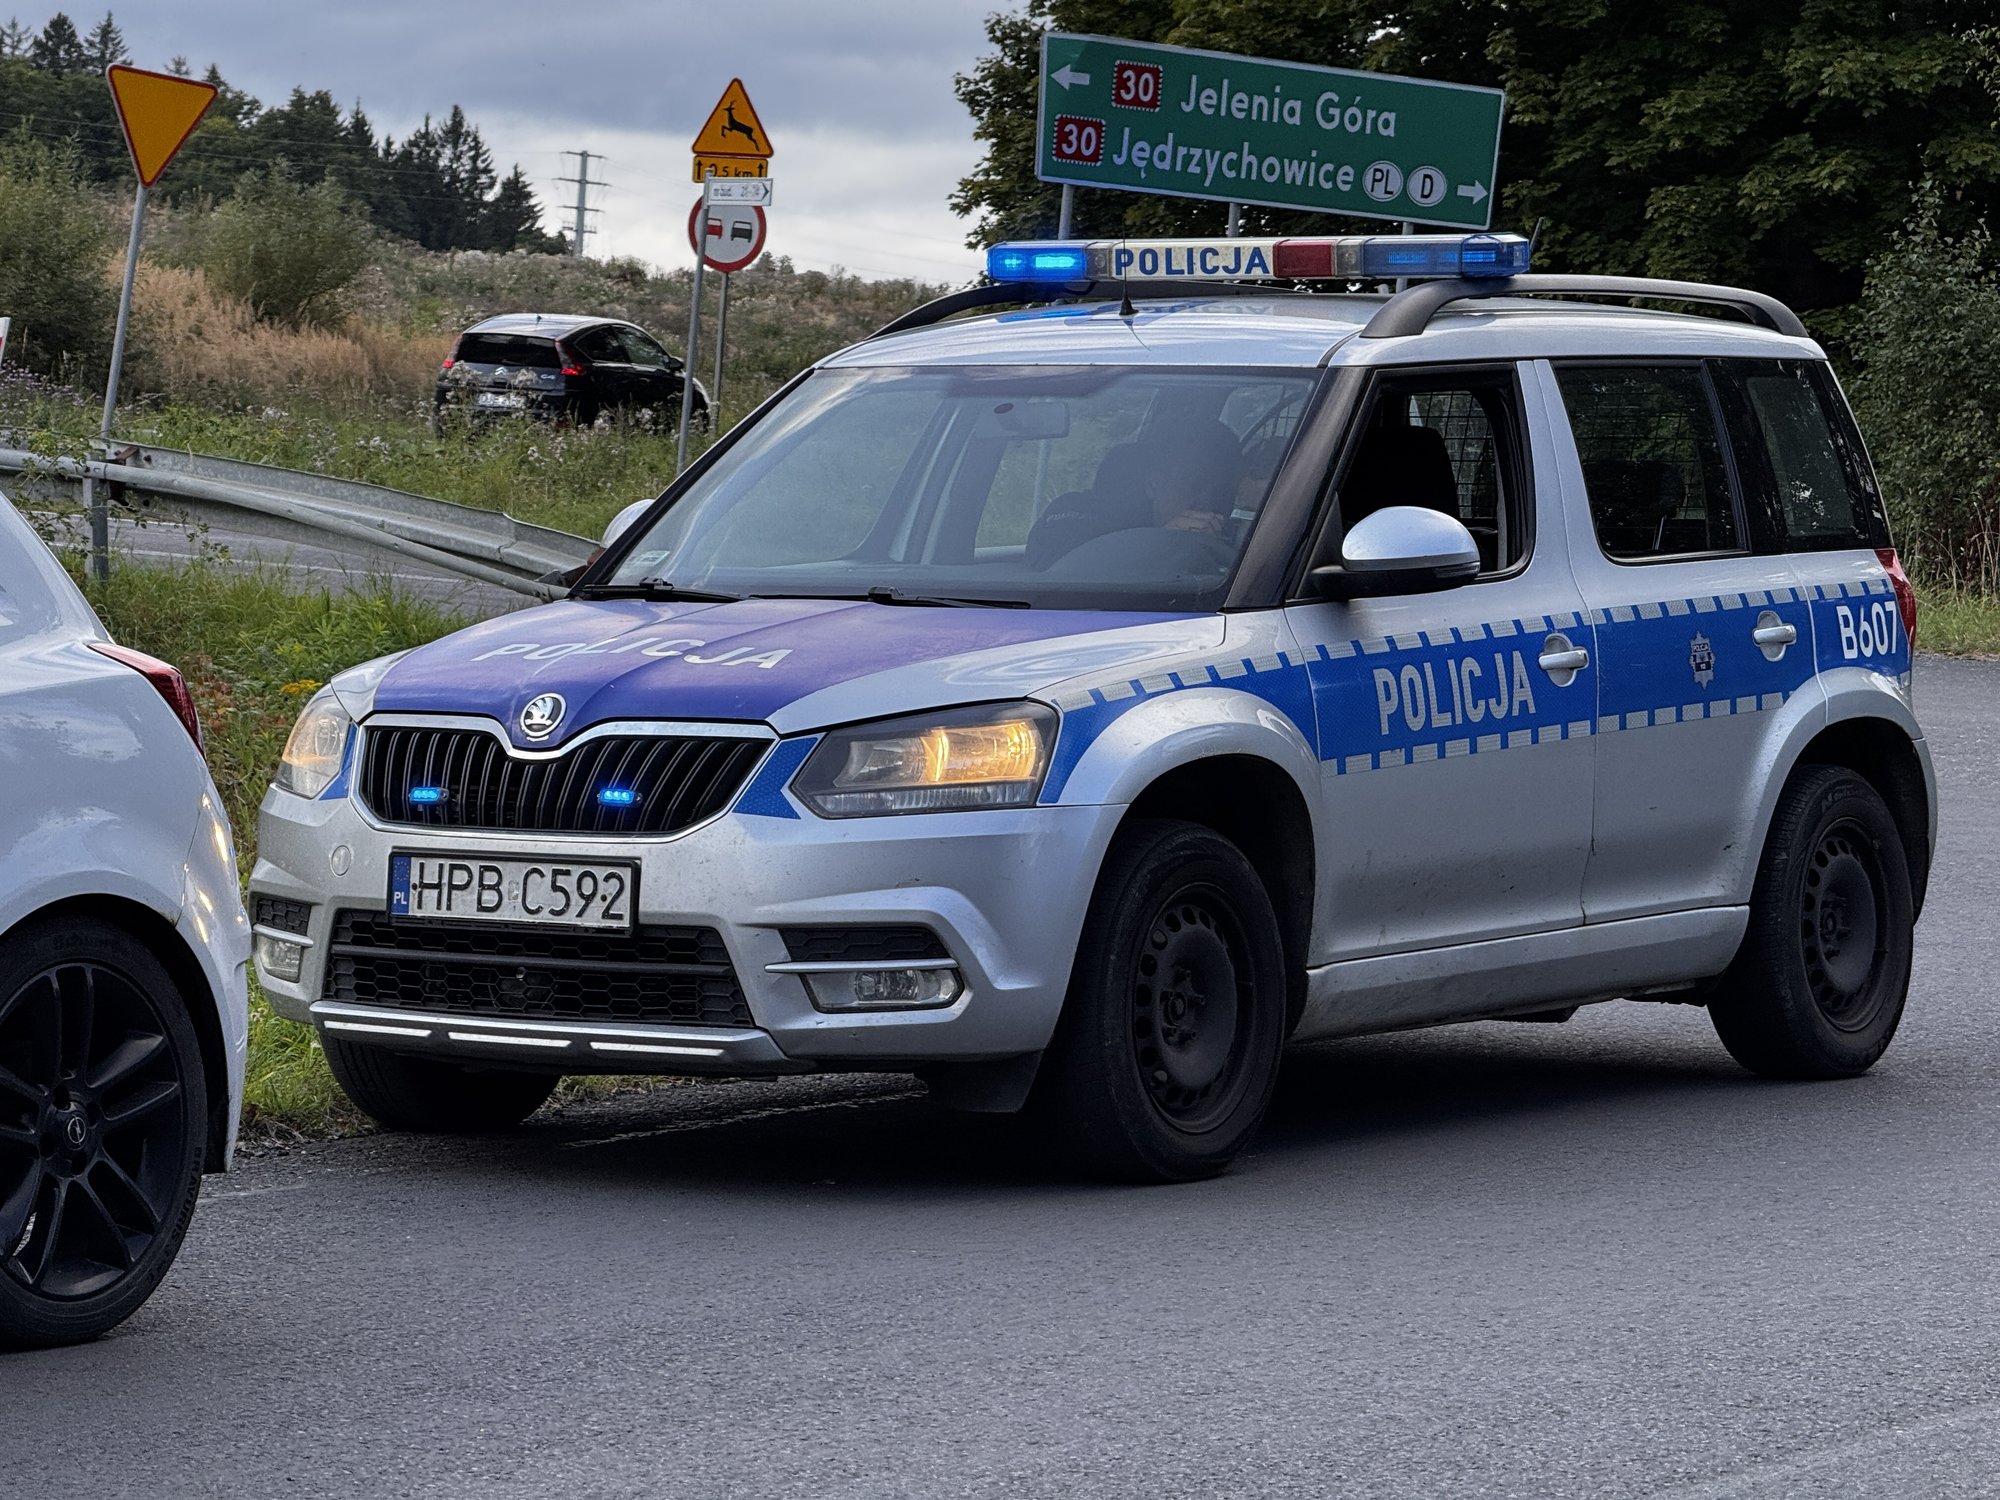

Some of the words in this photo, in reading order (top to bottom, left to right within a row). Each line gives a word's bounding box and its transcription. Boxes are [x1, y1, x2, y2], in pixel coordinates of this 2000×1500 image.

[1120, 70, 1154, 102] 30
[1180, 74, 1301, 126] Jelenia
[1315, 91, 1397, 138] Góra
[1061, 123, 1096, 157] 30
[1112, 127, 1355, 192] Jędrzychowice
[1370, 167, 1394, 196] PL
[1421, 173, 1434, 199] D
[1115, 247, 1270, 276] POLICJA
[1836, 601, 1897, 659] B607
[470, 638, 794, 669] POLICJA
[1373, 650, 1537, 736] POLICJA
[393, 891, 407, 905] PL
[417, 861, 503, 913] HPB
[521, 867, 625, 921] C592
